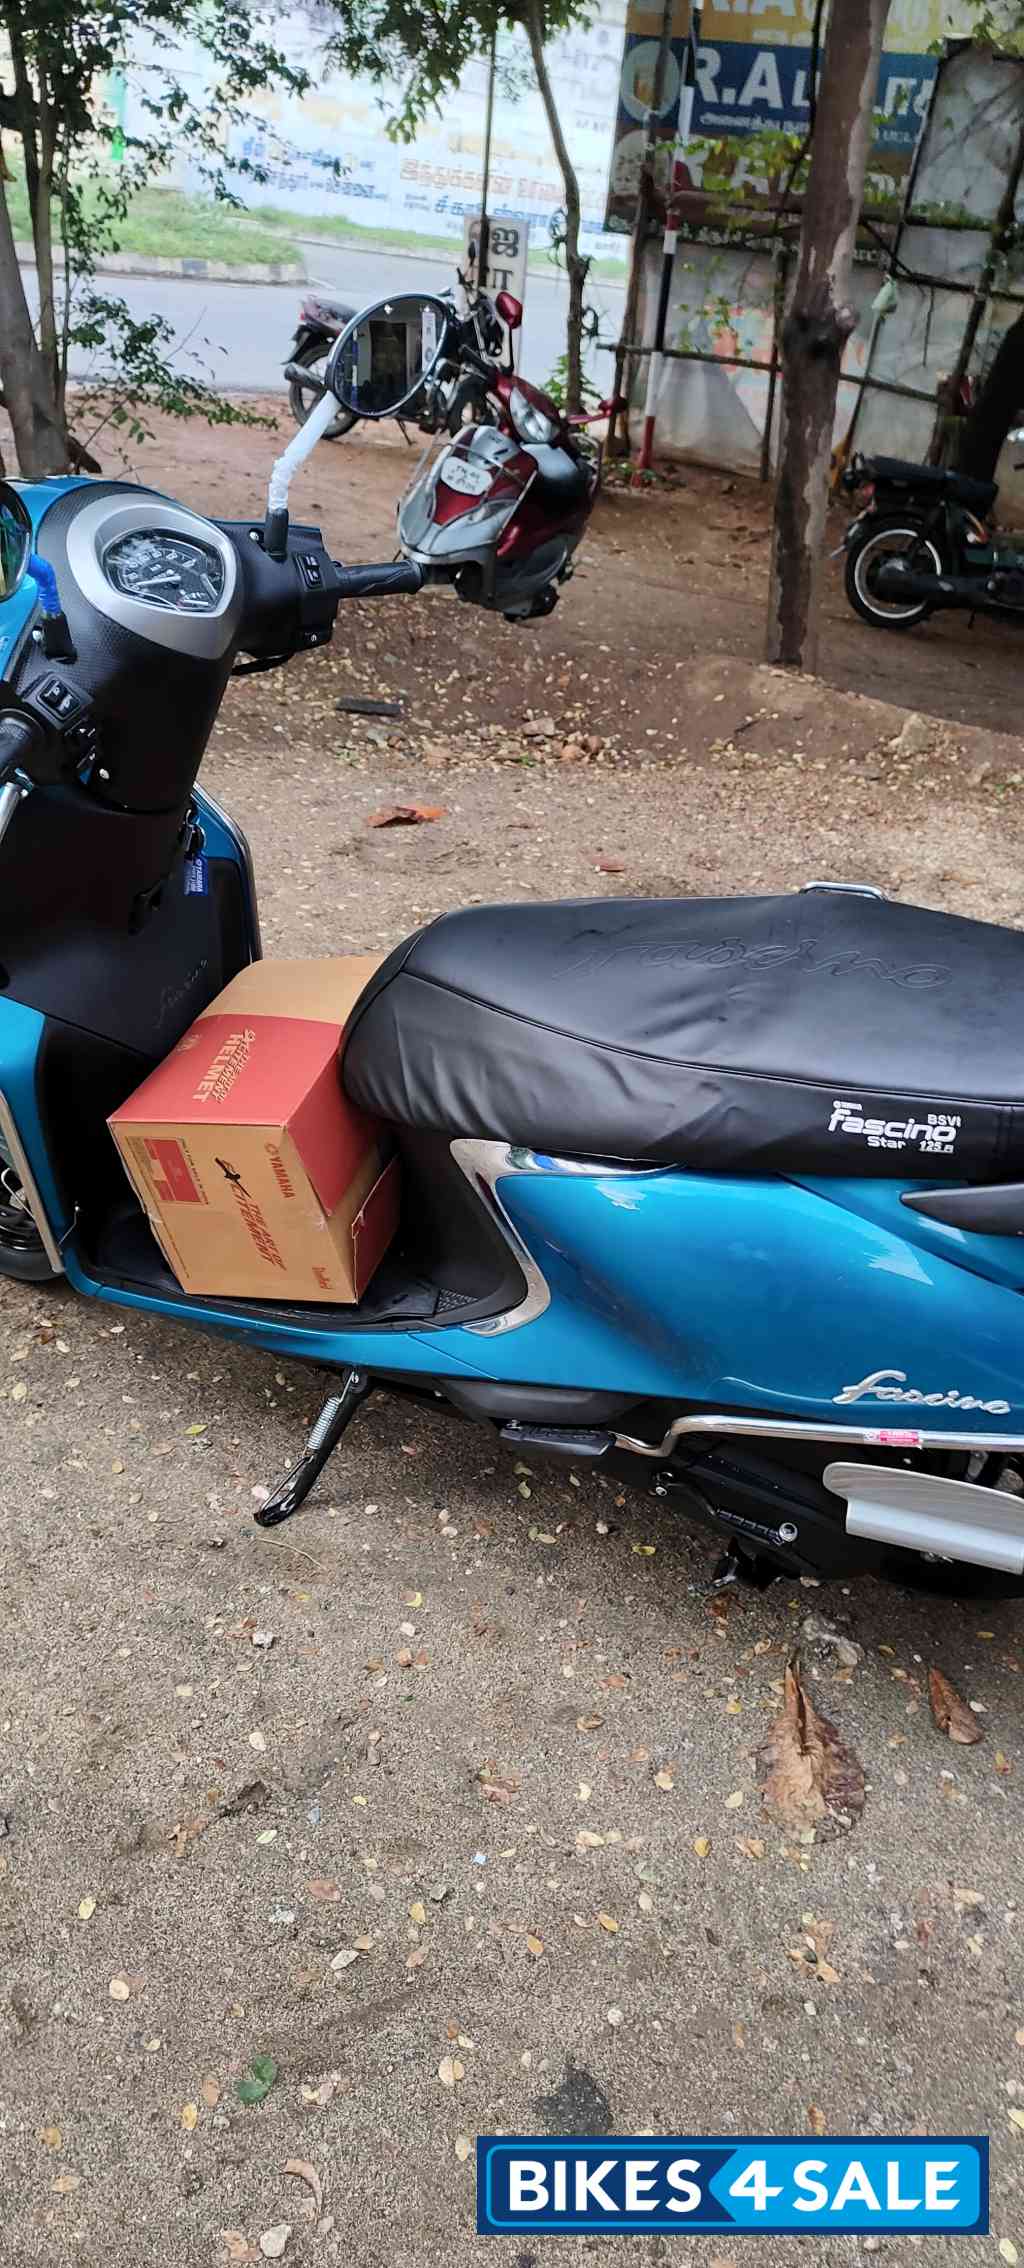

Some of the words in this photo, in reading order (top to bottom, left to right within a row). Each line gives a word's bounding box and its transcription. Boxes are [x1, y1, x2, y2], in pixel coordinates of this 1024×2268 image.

[192, 1033, 243, 1103] HELMET
[927, 1114, 962, 1127] BSVI
[867, 1136, 907, 1150] Star
[270, 1156, 296, 1198] YAMAHA
